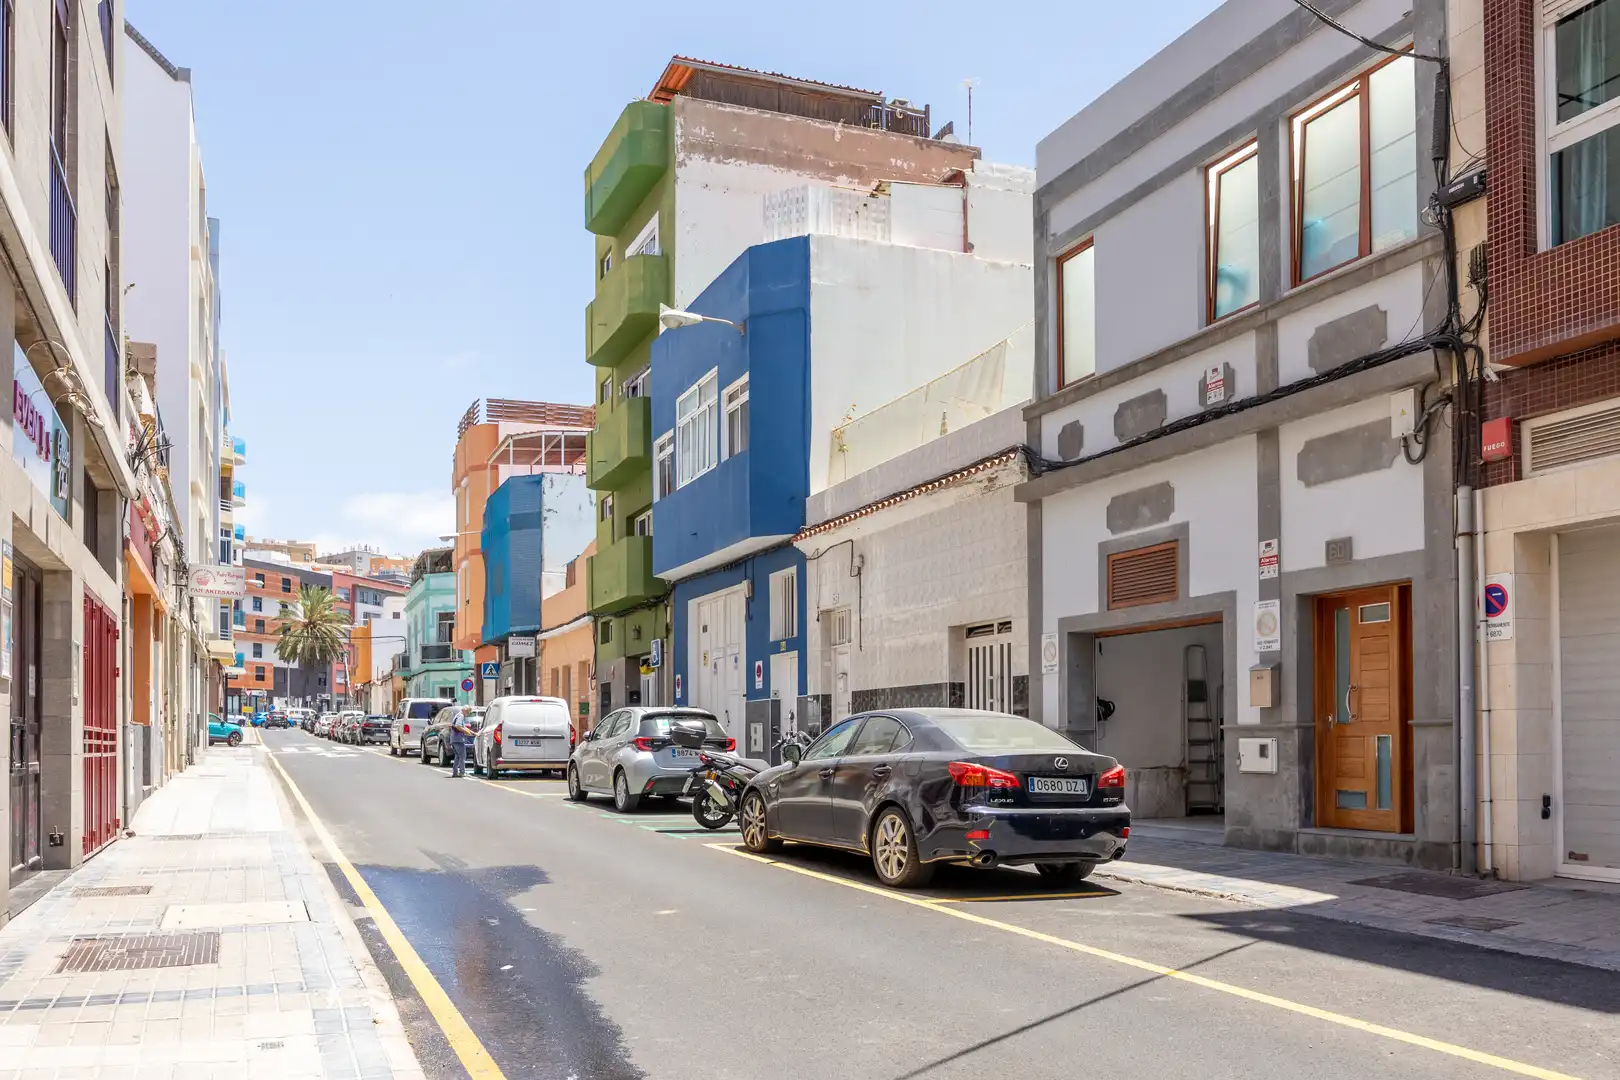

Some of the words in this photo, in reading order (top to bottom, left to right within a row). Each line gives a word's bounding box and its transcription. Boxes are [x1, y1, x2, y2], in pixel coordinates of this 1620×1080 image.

[1483, 441, 1505, 452] FUEGO
[205, 589, 242, 597] ARTESANAL
[1036, 779, 1063, 791] 0680
[1066, 781, 1085, 792] DZJ
